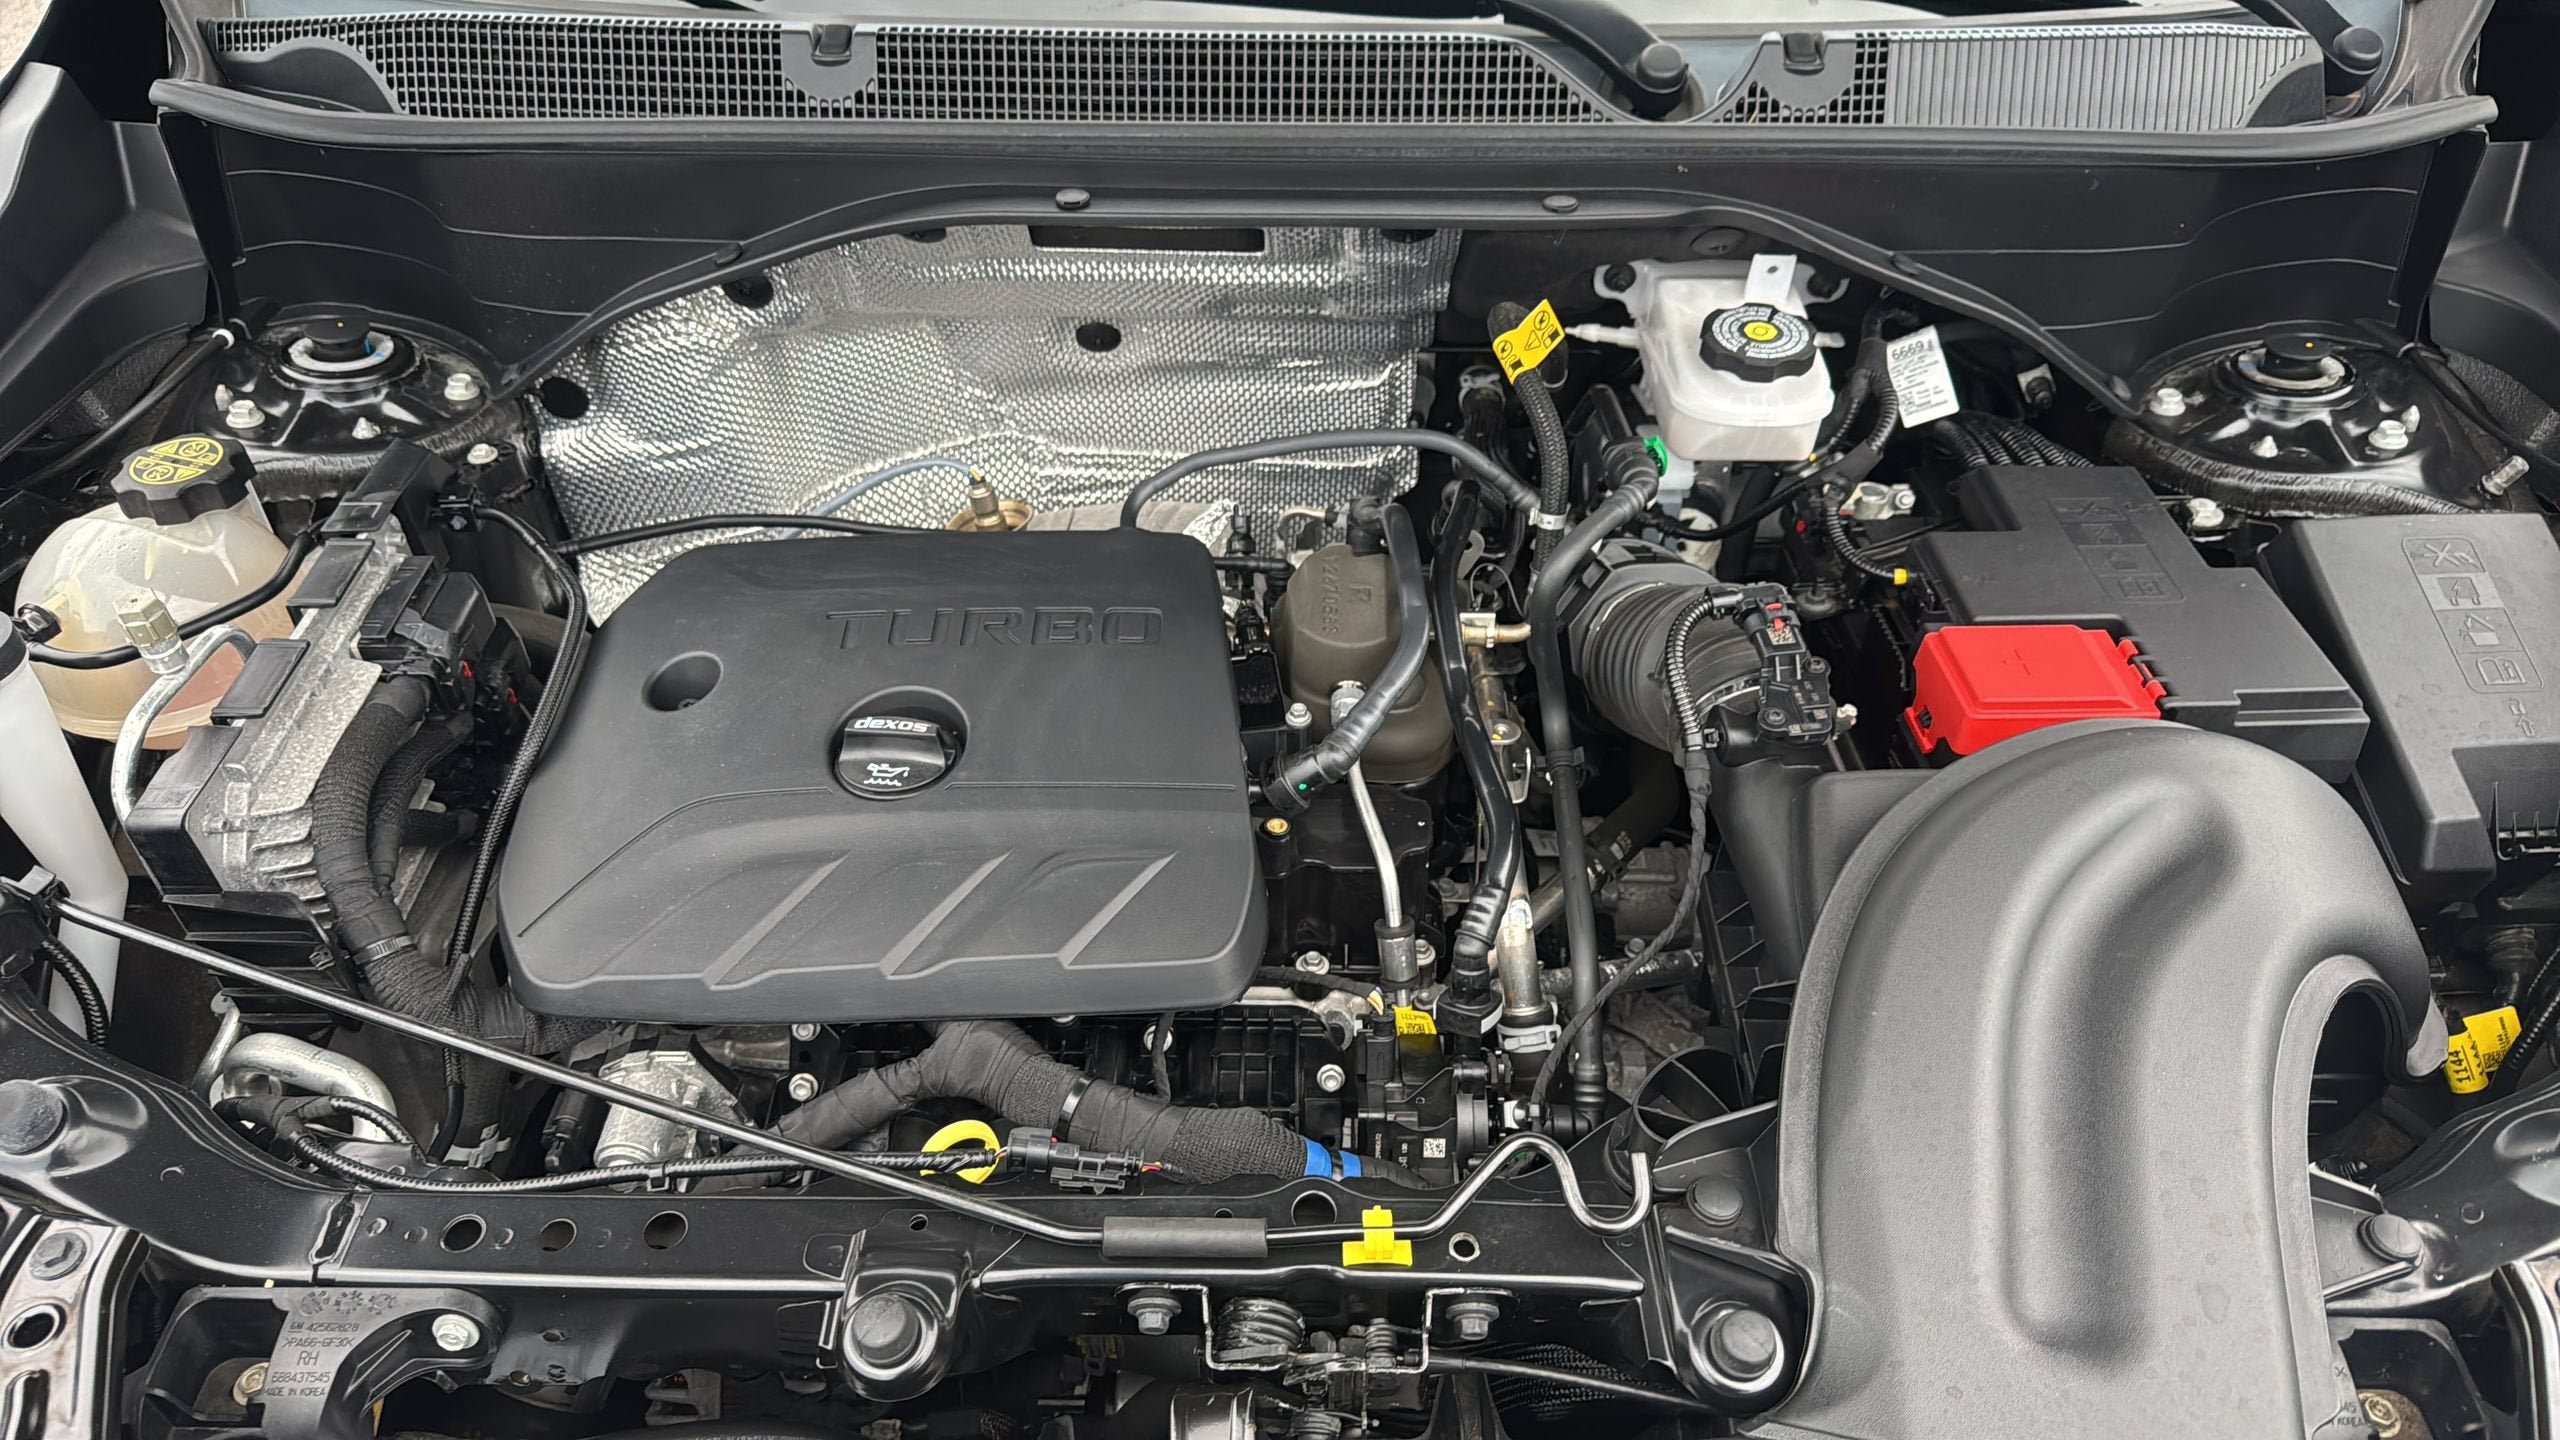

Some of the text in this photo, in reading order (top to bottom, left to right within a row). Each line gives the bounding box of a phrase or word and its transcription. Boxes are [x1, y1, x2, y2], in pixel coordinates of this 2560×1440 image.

[826, 606, 1163, 650] TURBO
[854, 716, 930, 733] dexos
[2448, 1050, 2471, 1083] 1144
[297, 1350, 320, 1366] RH
